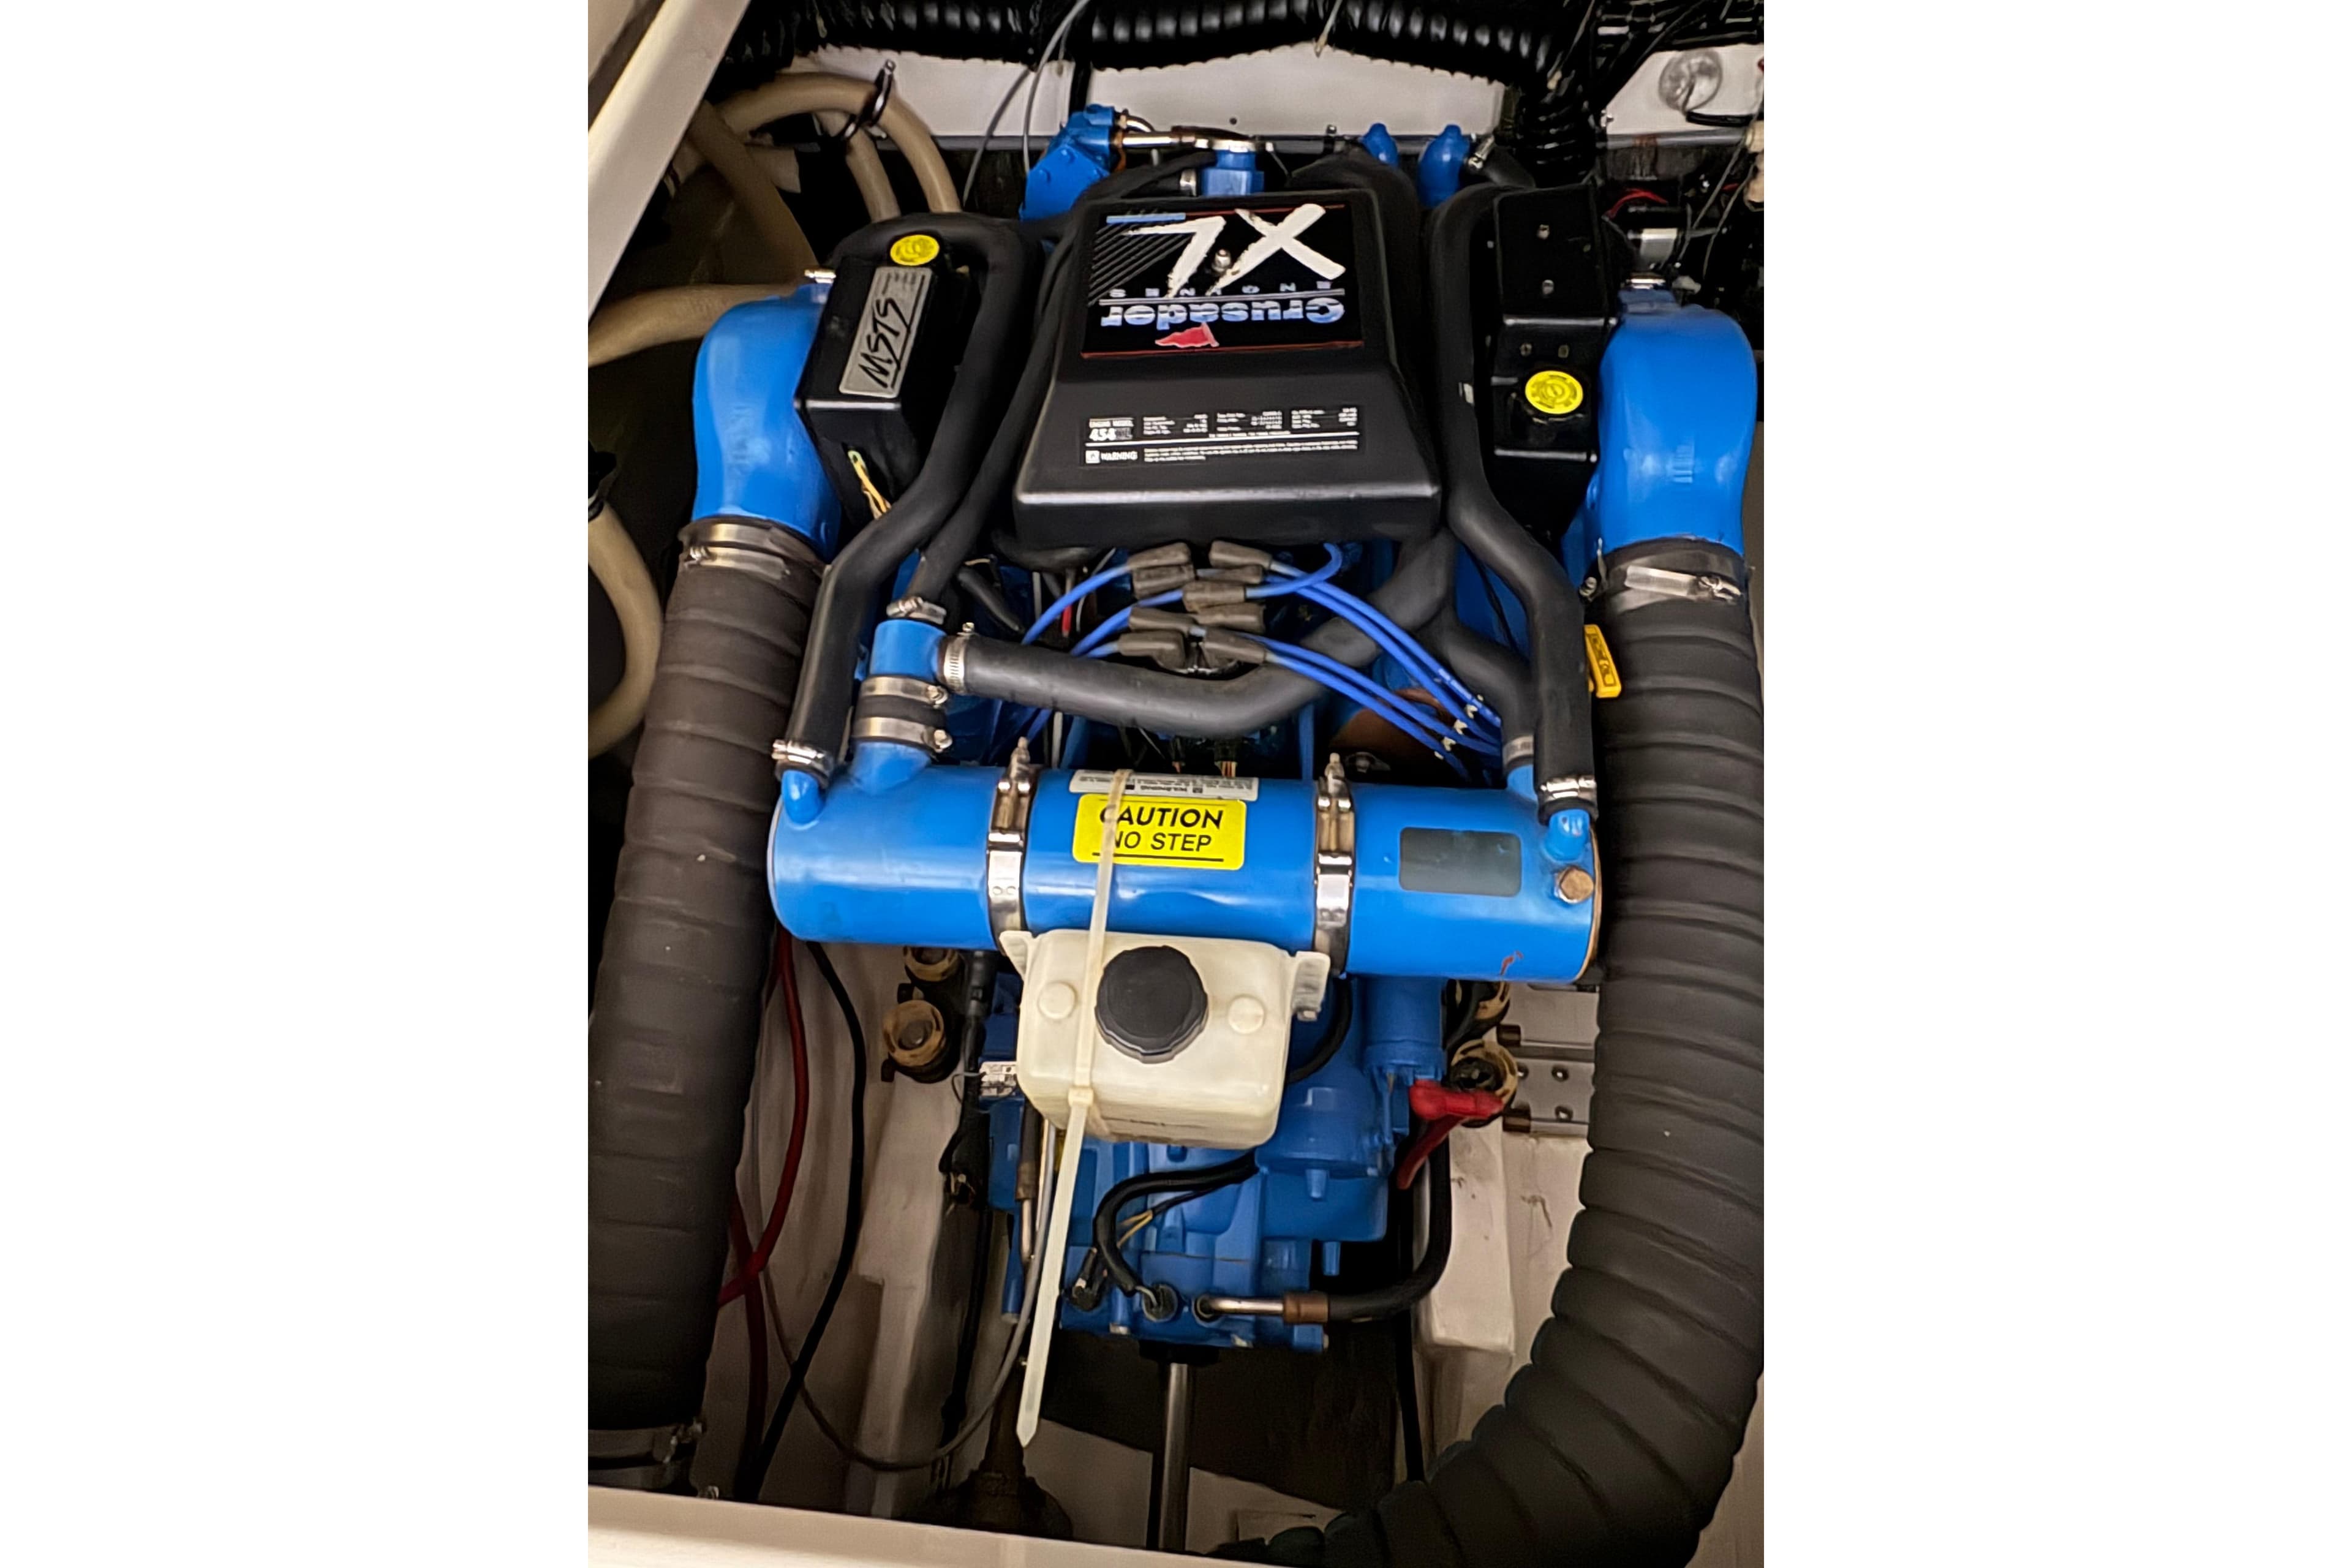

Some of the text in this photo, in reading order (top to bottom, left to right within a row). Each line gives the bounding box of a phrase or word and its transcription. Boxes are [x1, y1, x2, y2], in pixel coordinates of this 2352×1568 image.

[1122, 203, 1346, 298] XL
[1101, 298, 1346, 331] Crusader
[859, 298, 911, 388] MSTS
[1099, 804, 1224, 829] CAUTION
[1150, 832, 1212, 852] STEP
